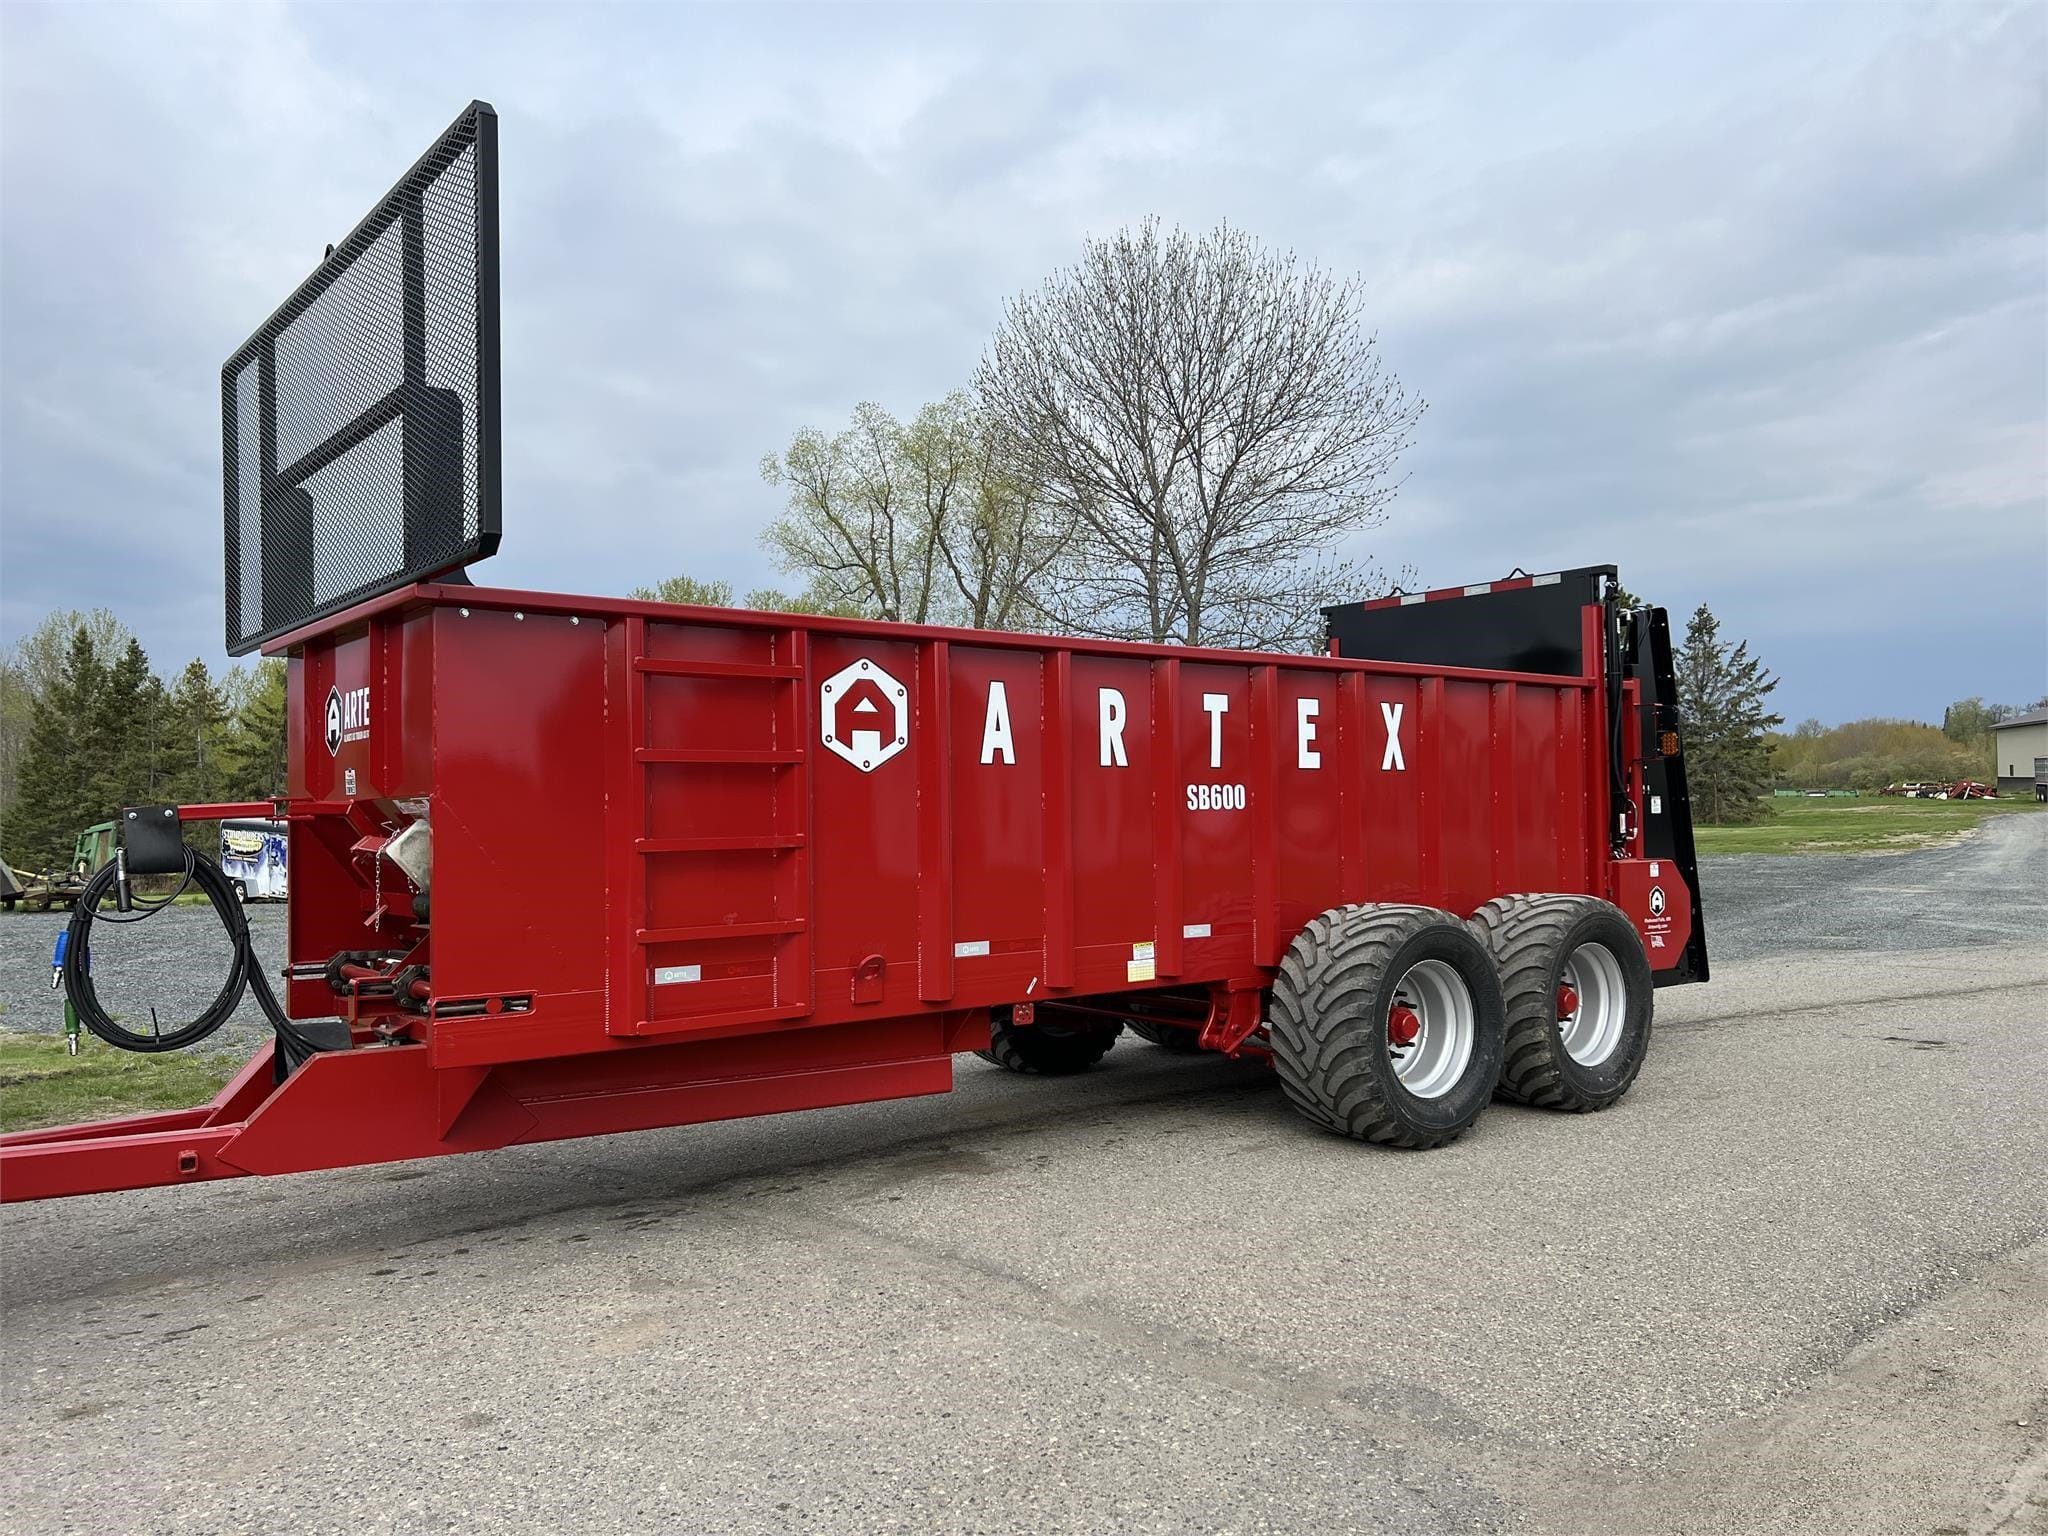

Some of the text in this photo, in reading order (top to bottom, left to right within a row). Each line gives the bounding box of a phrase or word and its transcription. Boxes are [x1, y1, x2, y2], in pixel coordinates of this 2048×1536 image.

[344, 687, 370, 730] ARTE
[979, 680, 1406, 772] ARTEX
[1186, 783, 1247, 811] SB600
